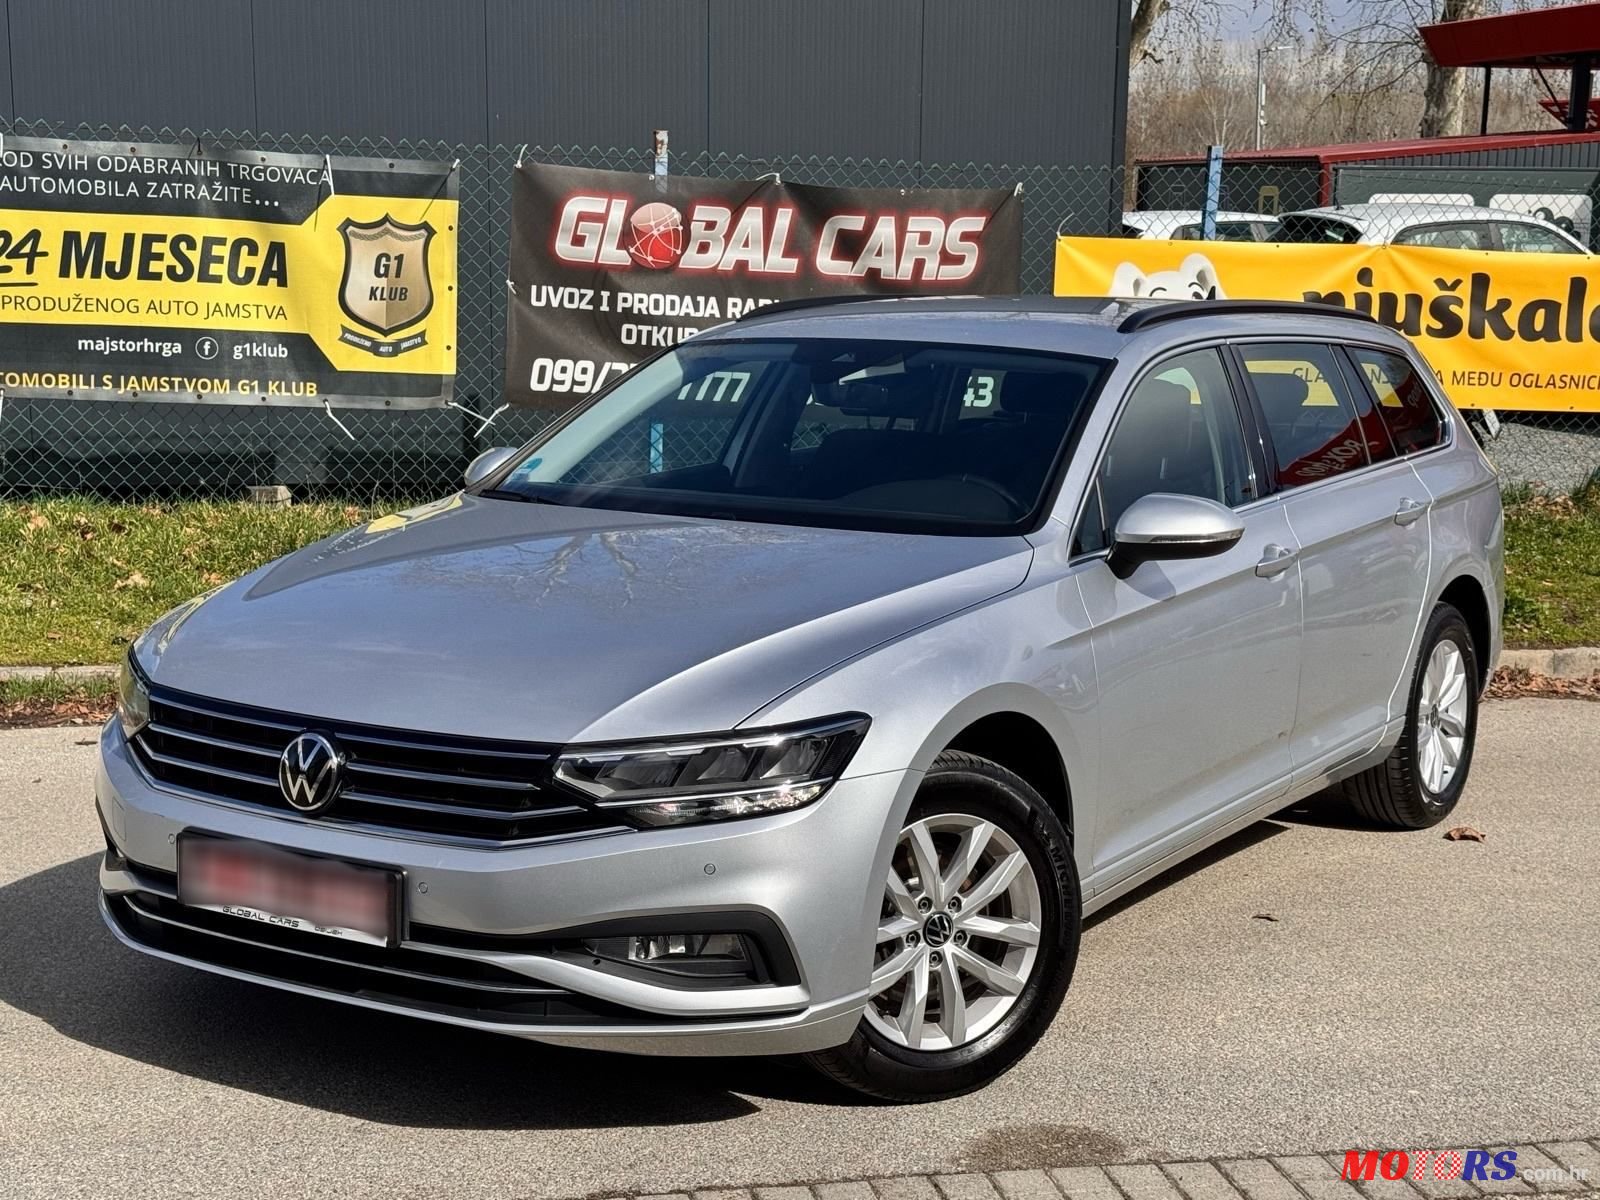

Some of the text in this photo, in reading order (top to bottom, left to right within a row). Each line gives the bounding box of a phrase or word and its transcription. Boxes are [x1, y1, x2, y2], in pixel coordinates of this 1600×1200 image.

[0, 151, 331, 187] OD SVIH ODABRANIH TRGOVACA
[0, 175, 139, 197] AUTOMOBILA
[555, 196, 987, 280] GLOBAL CARS
[58, 230, 288, 288] MJESECA
[374, 252, 404, 278] G1
[369, 286, 408, 301] KLUB
[530, 284, 780, 319] UVOZ I PRODAJA RA
[1, 293, 288, 320] PRODUŽENOG AUTO JAMSTVA
[78, 337, 182, 357] majstorhrga
[233, 343, 289, 360] g1klub
[102, 374, 113, 390] S
[117, 375, 230, 395] JAMSTVOM
[237, 379, 259, 395] G1
[268, 380, 317, 397] KLUB
[1451, 370, 1503, 387] MEĐU
[222, 905, 300, 928] GLOBAL CARS
